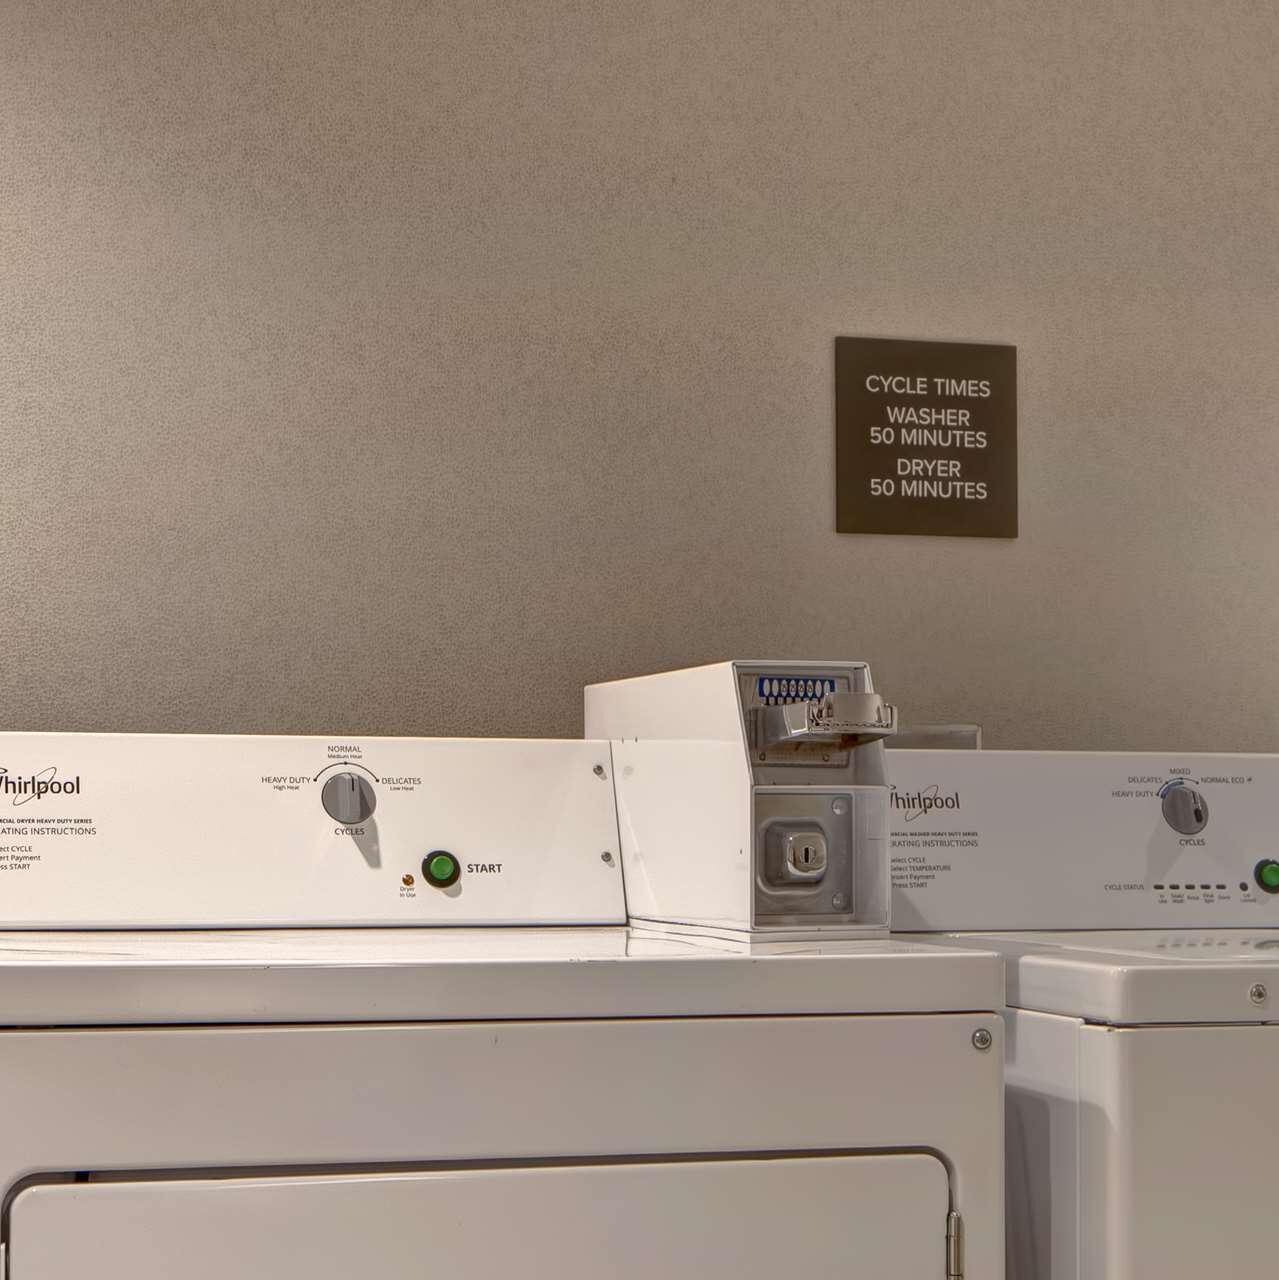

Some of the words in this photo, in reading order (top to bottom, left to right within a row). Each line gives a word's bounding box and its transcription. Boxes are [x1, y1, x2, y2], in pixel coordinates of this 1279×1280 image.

[865, 375, 928, 394] CYCLE
[933, 378, 991, 398] TIMES
[886, 406, 970, 426] WASHER
[870, 427, 895, 444] 50
[901, 429, 987, 448] MINUTES
[897, 459, 961, 478] DRYER
[870, 479, 895, 496] 50
[901, 480, 988, 499] MINUTES
[327, 745, 362, 753] NORMAL
[261, 776, 288, 784] HEAVY
[289, 776, 311, 784] DUTY
[381, 777, 422, 785] DELICATES
[890, 792, 960, 814] hirlpool
[30, 827, 97, 835] INSTRUCTIONS
[334, 828, 365, 836] CYCLES
[922, 840, 978, 848] INSTRUCTIONS
[11, 854, 41, 863] Payment
[467, 863, 502, 873] START
